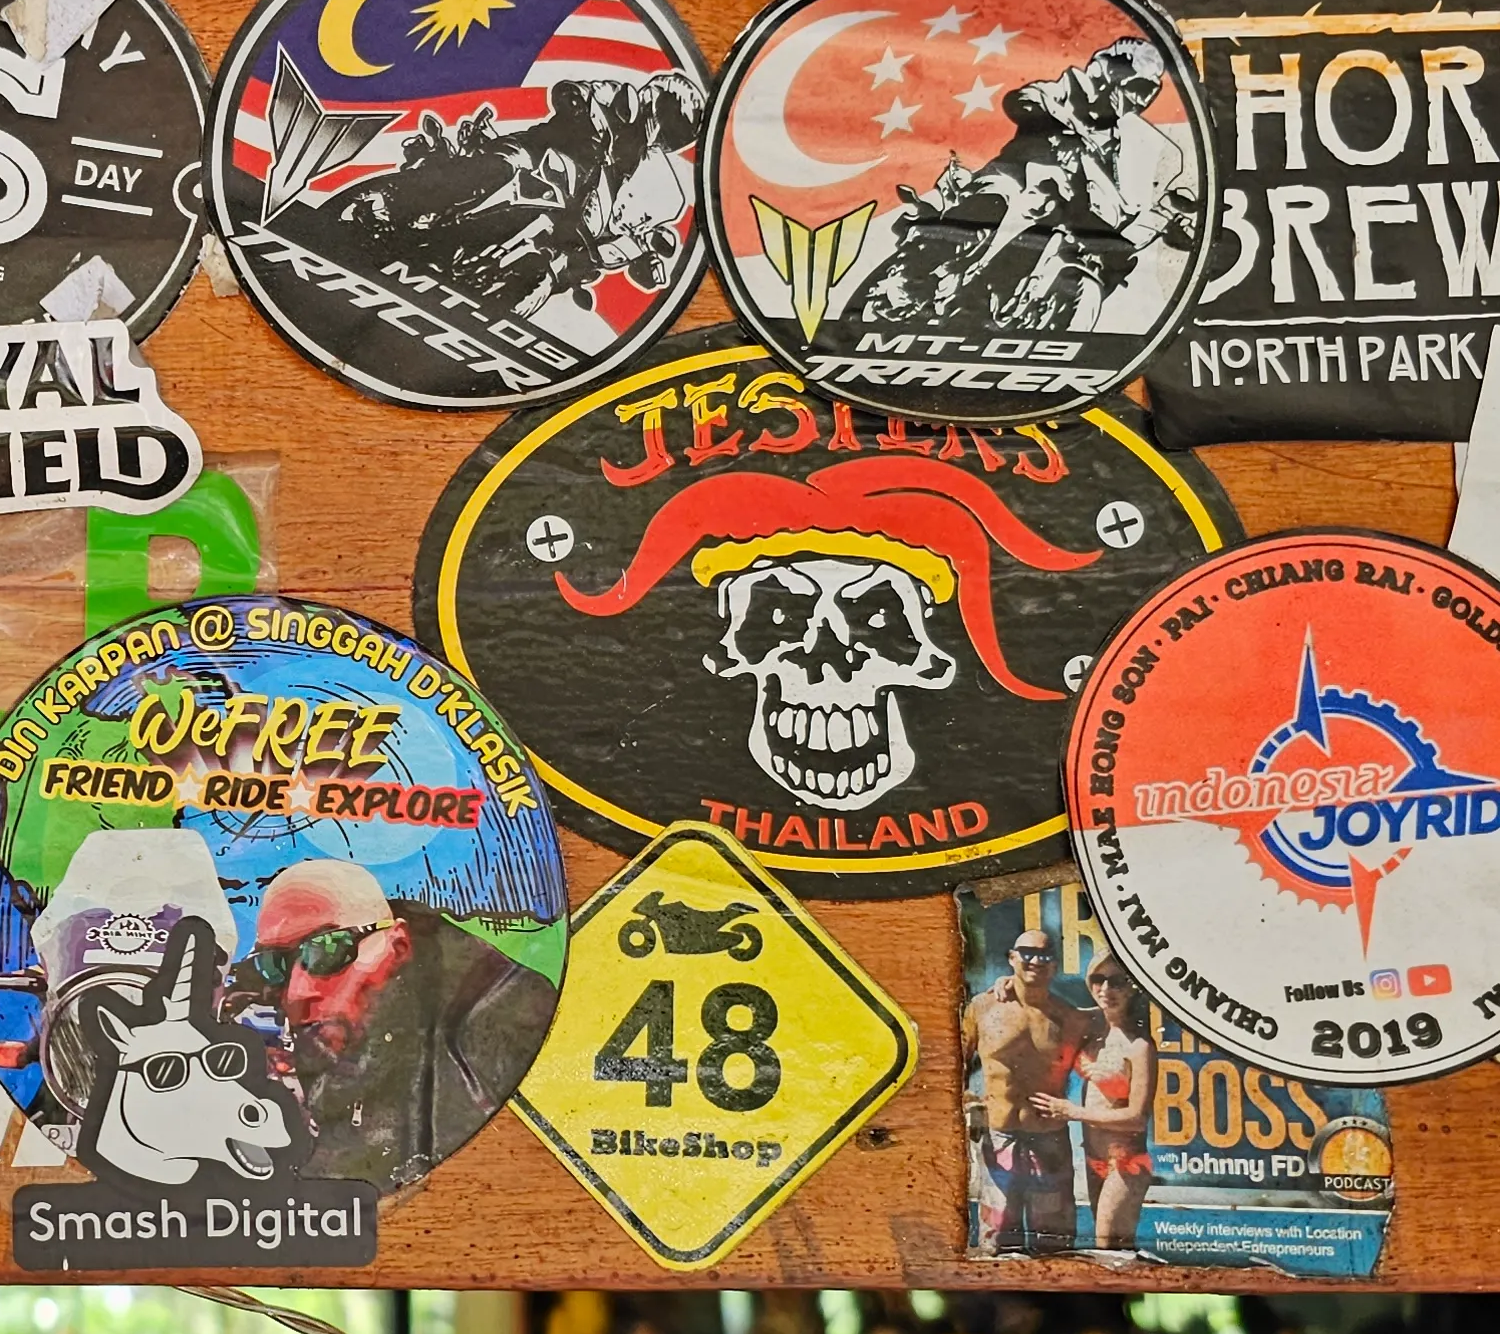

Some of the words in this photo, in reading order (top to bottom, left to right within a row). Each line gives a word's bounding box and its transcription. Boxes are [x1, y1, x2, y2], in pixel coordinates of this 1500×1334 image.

[73, 159, 144, 194] DAY
[228, 221, 552, 392] TRACER
[381, 260, 580, 372] MT-09
[855, 332, 1083, 362] MT-09
[1190, 335, 1346, 388] NORTH
[1358, 332, 1484, 383] PARK
[805, 354, 1119, 395] TRACER
[1224, 558, 1345, 602] CHIANG
[1354, 561, 1415, 596] RAI
[1159, 595, 1211, 643] PAI
[36, 620, 181, 725] KARPAN
[190, 605, 235, 650] @
[247, 607, 409, 679] SINGGAH
[1111, 643, 1162, 706] SON
[1089, 708, 1126, 797] HONG
[44, 765, 175, 803] FRIEND
[202, 774, 290, 812] RIDE
[316, 783, 480, 825] EXPLORE
[702, 797, 990, 853] THAILAND
[1091, 807, 1130, 882] MAE
[1116, 893, 1170, 961] MAI
[1164, 958, 1279, 1043] CHIANG
[1284, 984, 1338, 1004] Follow
[1340, 980, 1365, 999] Us
[594, 979, 783, 1113] 48
[1311, 1011, 1444, 1059] 2019
[1154, 1060, 1329, 1151] BOSS
[589, 1129, 784, 1167] BikeShop
[1157, 1153, 1178, 1163] with
[1173, 1152, 1265, 1183] Johnny
[1271, 1154, 1306, 1178] FD
[1324, 1176, 1392, 1191] PODCAST
[28, 1198, 189, 1242] Smash
[206, 1197, 363, 1250] Digital
[1154, 1221, 1204, 1238] Weekly
[1206, 1223, 1273, 1238] interviews
[1275, 1226, 1303, 1239] with
[1305, 1226, 1363, 1241] Location
